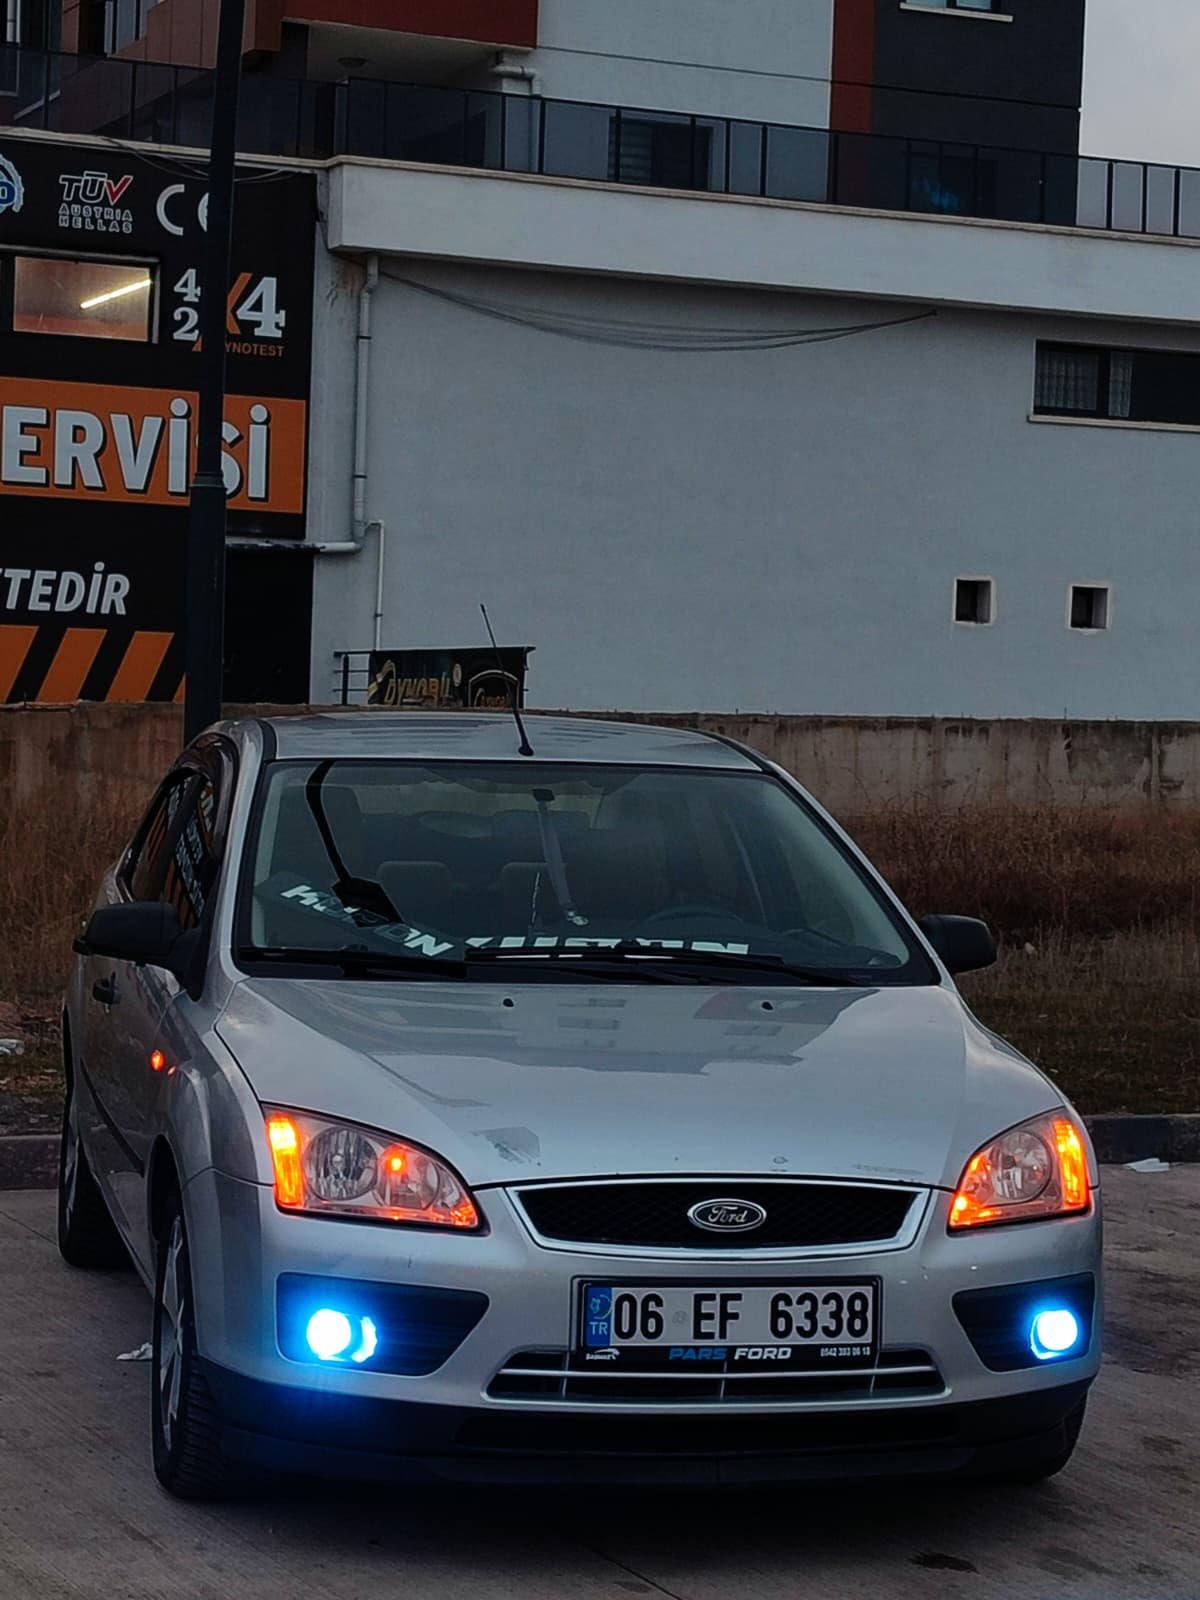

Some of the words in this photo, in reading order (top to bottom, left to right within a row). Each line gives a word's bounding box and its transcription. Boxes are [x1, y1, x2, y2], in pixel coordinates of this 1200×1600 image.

[58, 204, 133, 222] AUSTRIA
[58, 215, 133, 234] HELLAS
[224, 341, 285, 357] YNOTEST
[0, 561, 130, 616] TEDİR
[708, 1205, 748, 1223] Ford
[613, 1292, 664, 1340] 06
[693, 1292, 743, 1340] EF
[769, 1291, 869, 1339] 6338
[590, 1321, 608, 1336] TR
[668, 1347, 728, 1361] PARS
[734, 1347, 792, 1361] FORD
